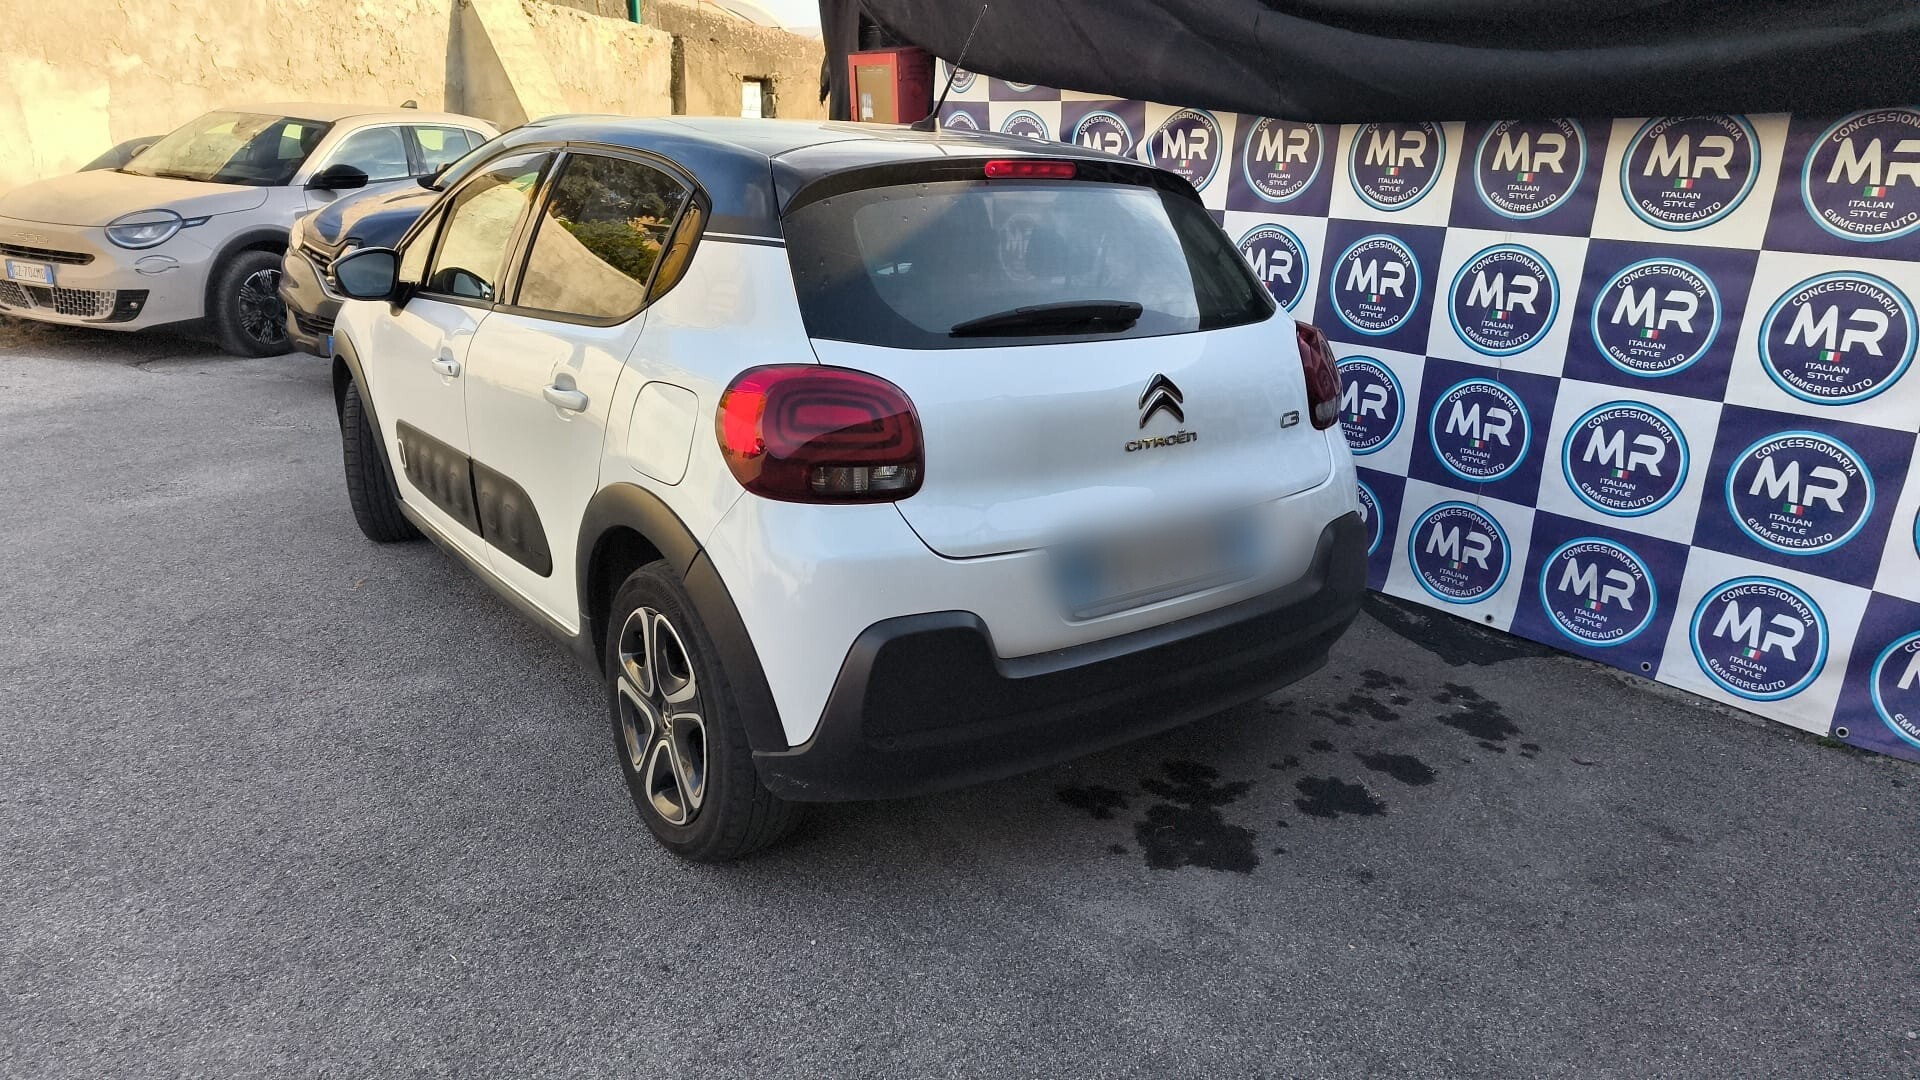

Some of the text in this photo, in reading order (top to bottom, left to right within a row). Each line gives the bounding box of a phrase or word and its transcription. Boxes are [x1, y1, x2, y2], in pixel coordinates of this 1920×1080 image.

[1832, 112, 1920, 142] CONCESSION
[1162, 128, 1209, 160] MR
[1256, 128, 1310, 163] MR
[1364, 129, 1427, 168] MR
[1491, 131, 1567, 173] MR
[1643, 133, 1735, 179] MR
[1826, 137, 1920, 187] MR
[1256, 179, 1303, 196] EMMERREAUTO
[1364, 184, 1418, 203] EMMERREAUTO
[1377, 177, 1404, 185] ITALIAN
[1507, 184, 1540, 192] ITALIAN
[1490, 192, 1557, 212] EMMERREAUTO
[1508, 192, 1536, 200] STYLE
[1661, 191, 1701, 199] ITALIAN
[1663, 200, 1696, 208] STYLE
[1848, 200, 1894, 209] ITALIAN
[1641, 199, 1721, 221] EMMERREAUTO
[1824, 208, 1918, 232] EMMERREAUTO
[1849, 210, 1888, 219] STYLE
[1242, 231, 1298, 256] CONCESSIONARIA
[1348, 241, 1411, 267] CONCESSIONARIA
[1246, 247, 1293, 283] MR
[1345, 257, 1406, 298] MR
[1471, 252, 1545, 282] CONCESSIONARIA
[1466, 270, 1539, 314] MR
[1617, 266, 1707, 298] CONCESSIONARIA
[1359, 303, 1386, 312] ITALIAN
[1610, 284, 1698, 333] MR
[1792, 281, 1900, 317] CONCESSIONARIA
[1345, 309, 1399, 328] EMMERREAUTO
[1360, 311, 1383, 319] STYLE
[1481, 320, 1514, 330] ITALIAN
[1465, 326, 1530, 348] EMMERREAUTO
[1482, 328, 1509, 337] STYLE
[1784, 302, 1889, 356] MR
[1609, 345, 1685, 369] EMMERREAUTO
[1628, 339, 1666, 350] ITALIAN
[1629, 348, 1661, 358] STYLE
[1338, 363, 1393, 392] NCESSIONARIA
[1804, 362, 1850, 374] ITALIAN
[1807, 371, 1844, 383] STYLE
[1782, 368, 1873, 395] EMMERREAUTO
[1340, 380, 1388, 420] MR
[1448, 385, 1519, 416] CONCESSIONARIA
[1445, 399, 1513, 446] MR
[1587, 409, 1673, 443] CONCESSIONARIA
[1445, 452, 1505, 475] EMMERREAUTO
[1460, 447, 1490, 459] ITALIAN
[1461, 455, 1487, 465] STYLE
[1582, 425, 1666, 477] MR
[1754, 439, 1857, 477] CONCESSIONARIA
[1581, 482, 1654, 508] EMMERREAUTO
[1600, 477, 1636, 490] ITALIAN
[1601, 486, 1631, 498] STYLE
[1748, 456, 1848, 513] MR
[1429, 508, 1498, 541] CONCESSIONARIA
[1747, 517, 1833, 547] EMMERREAUTO
[1769, 513, 1813, 528] ITALIAN
[1771, 522, 1806, 535] STYLE
[1425, 521, 1492, 570] MR
[1439, 567, 1469, 581] ITALIAN
[1562, 544, 1643, 581] CONCESSIONARIA
[1424, 571, 1483, 596] EMMERREAUTO
[1440, 575, 1465, 587] STYLE
[1558, 557, 1636, 611] MR
[1573, 607, 1608, 622] ITALIAN
[1720, 585, 1814, 628] CONCESSIONARIA
[1556, 610, 1624, 639] EMMERREAUTO
[1574, 615, 1602, 629] STYLE
[1712, 600, 1805, 662] MR
[1709, 658, 1786, 692] EMMERREAUTO
[1729, 655, 1767, 673] ITALIAN
[1729, 664, 1762, 680] STYLE
